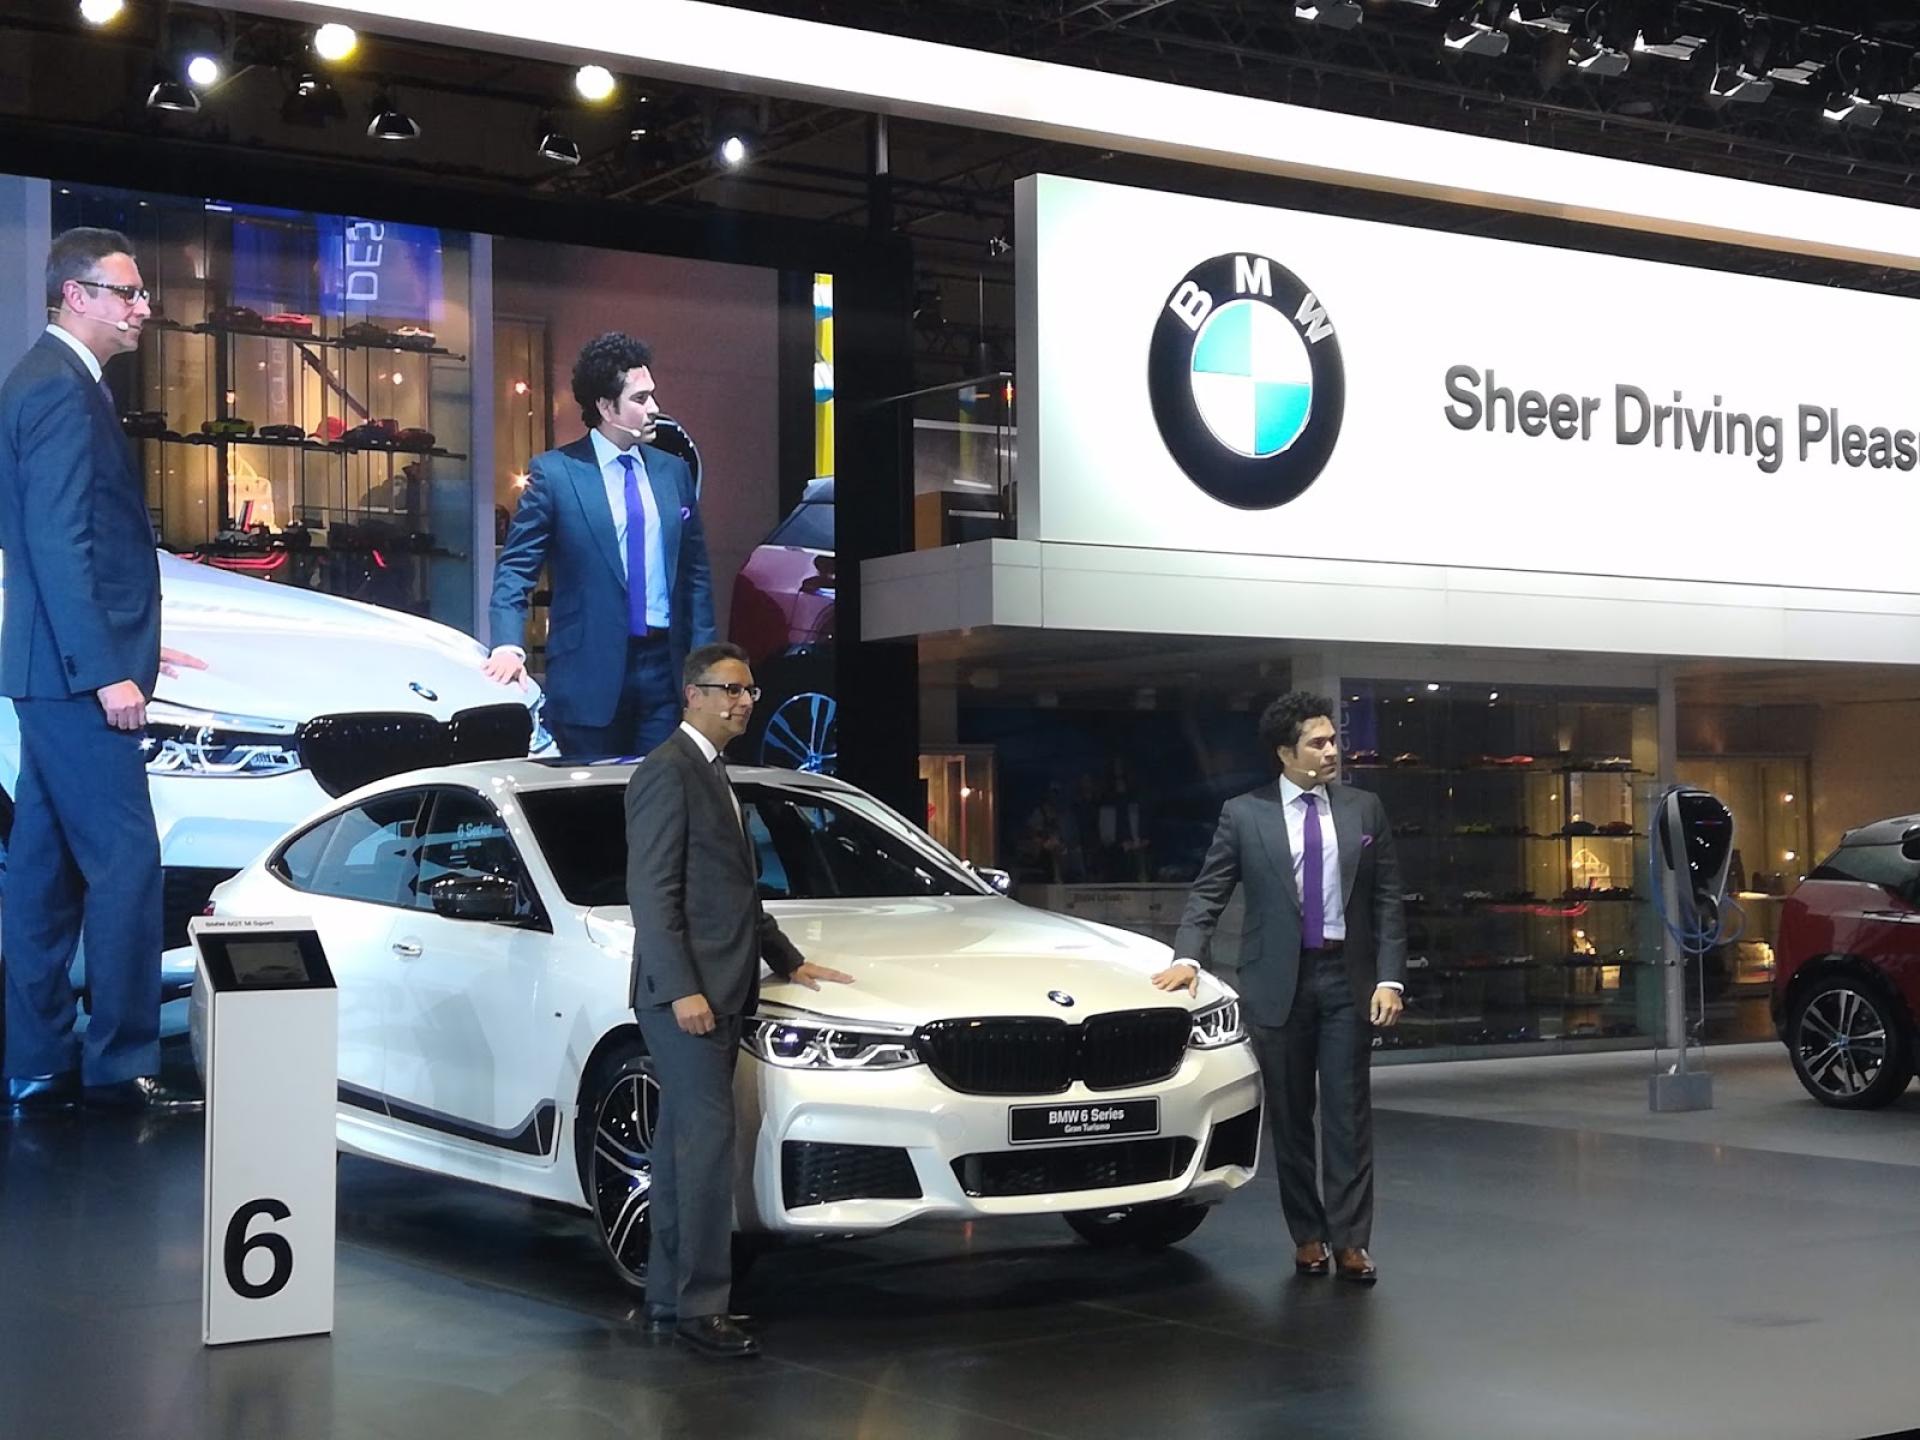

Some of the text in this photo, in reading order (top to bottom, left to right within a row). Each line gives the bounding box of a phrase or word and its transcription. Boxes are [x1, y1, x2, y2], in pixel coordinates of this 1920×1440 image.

[1169, 255, 1334, 344] BMW
[1444, 364, 1920, 474] Sheer Driving Pleas
[1049, 1107, 1125, 1124] BMW 6 Series
[1064, 1123, 1111, 1133] Gran Turismo
[224, 1198, 293, 1299] 6
